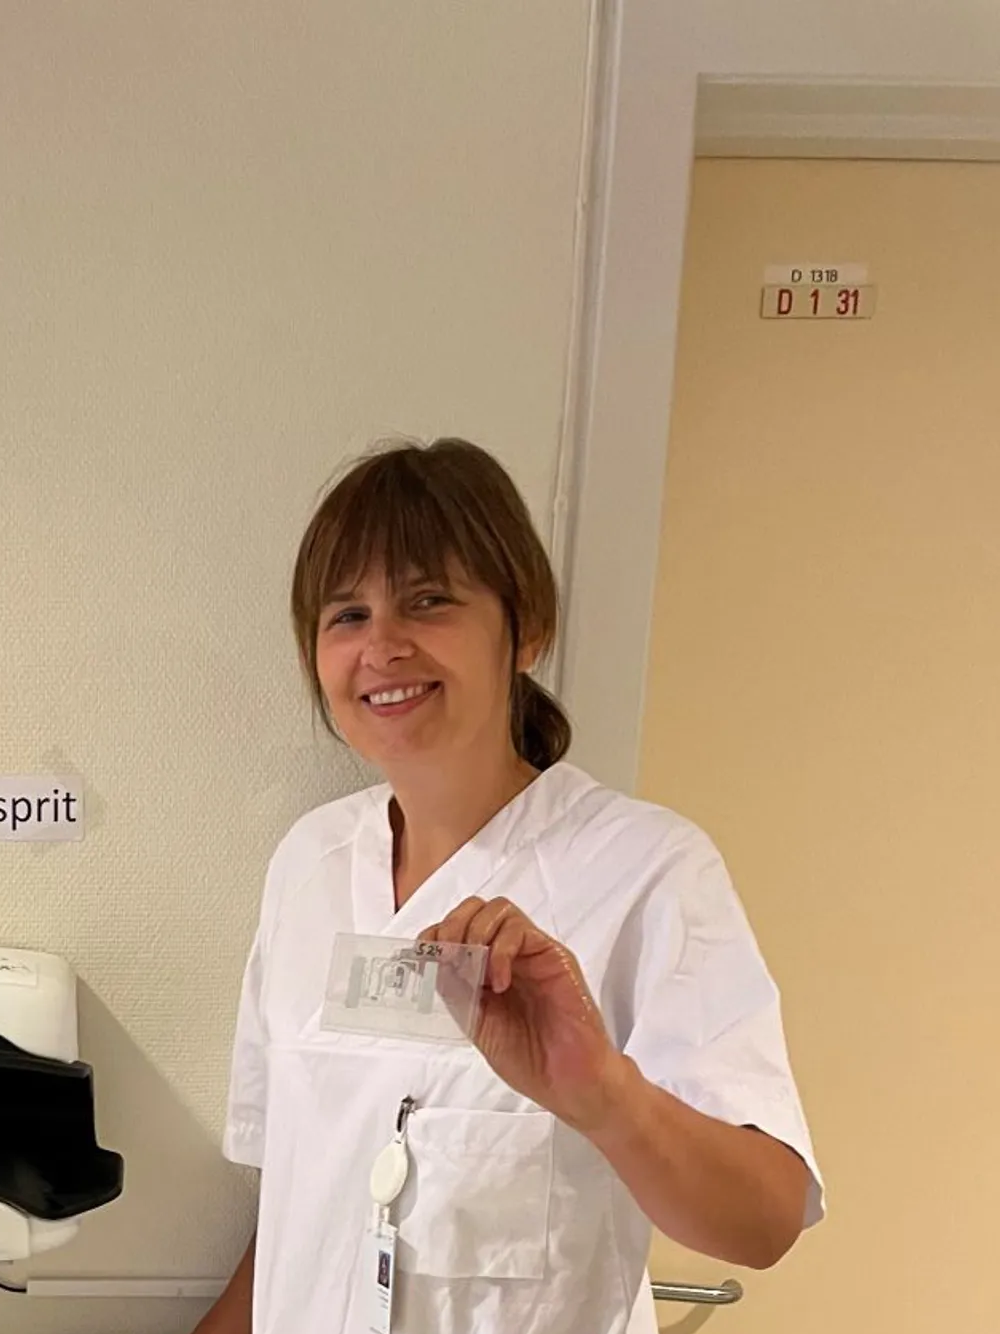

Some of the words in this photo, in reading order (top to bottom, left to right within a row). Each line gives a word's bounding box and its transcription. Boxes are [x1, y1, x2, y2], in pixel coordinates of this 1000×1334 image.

[791, 269, 802, 283] D
[777, 288, 793, 315] D
[810, 288, 820, 315] 1
[836, 288, 859, 315] 31
